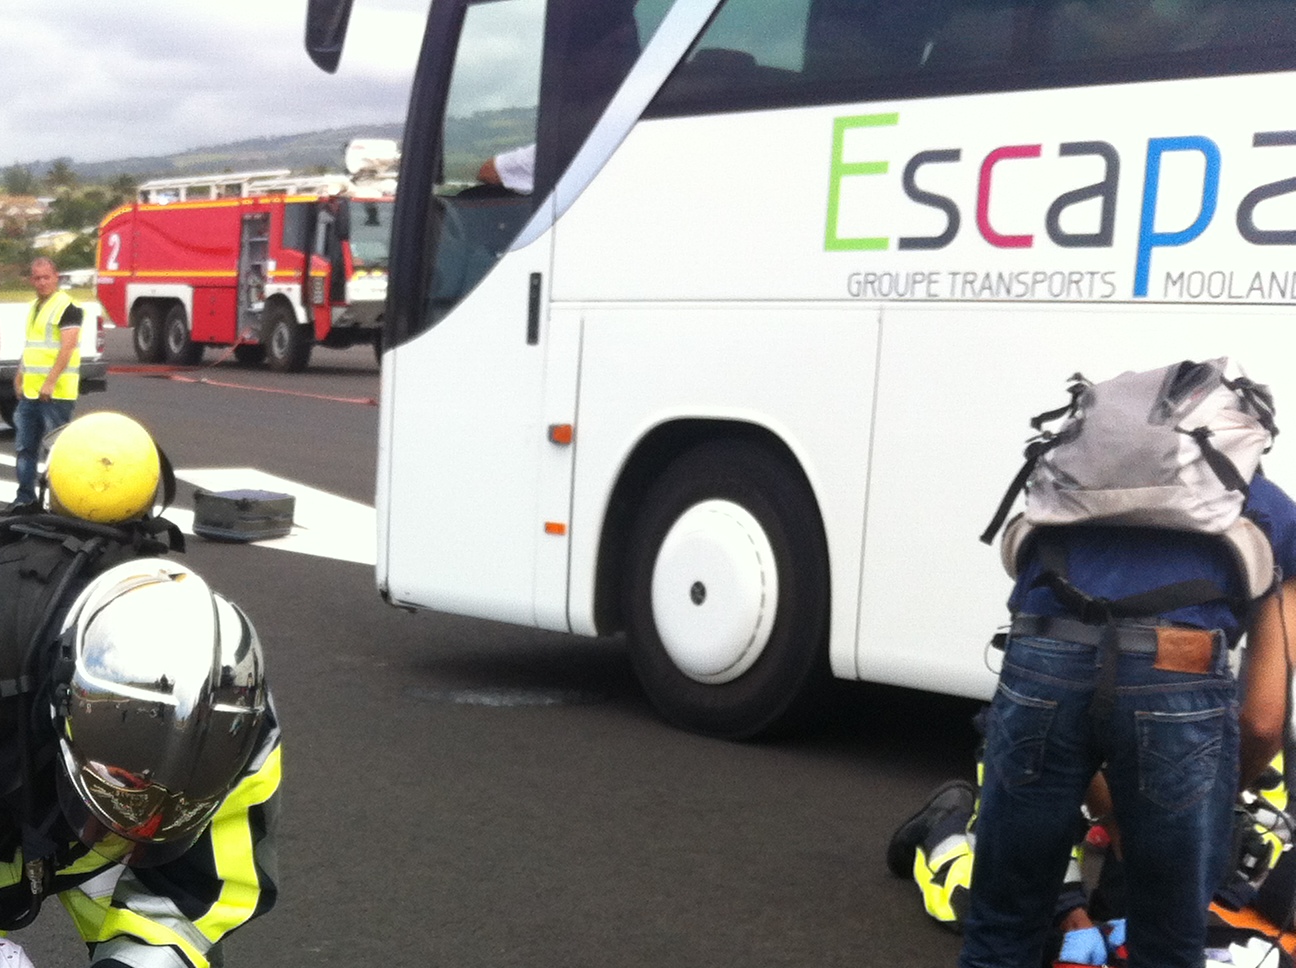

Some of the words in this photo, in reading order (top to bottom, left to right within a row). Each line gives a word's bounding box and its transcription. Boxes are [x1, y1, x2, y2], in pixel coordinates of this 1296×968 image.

[106, 233, 121, 271] 2
[847, 271, 941, 298] GROUPE
[949, 270, 1117, 298] TRANSPORTS
